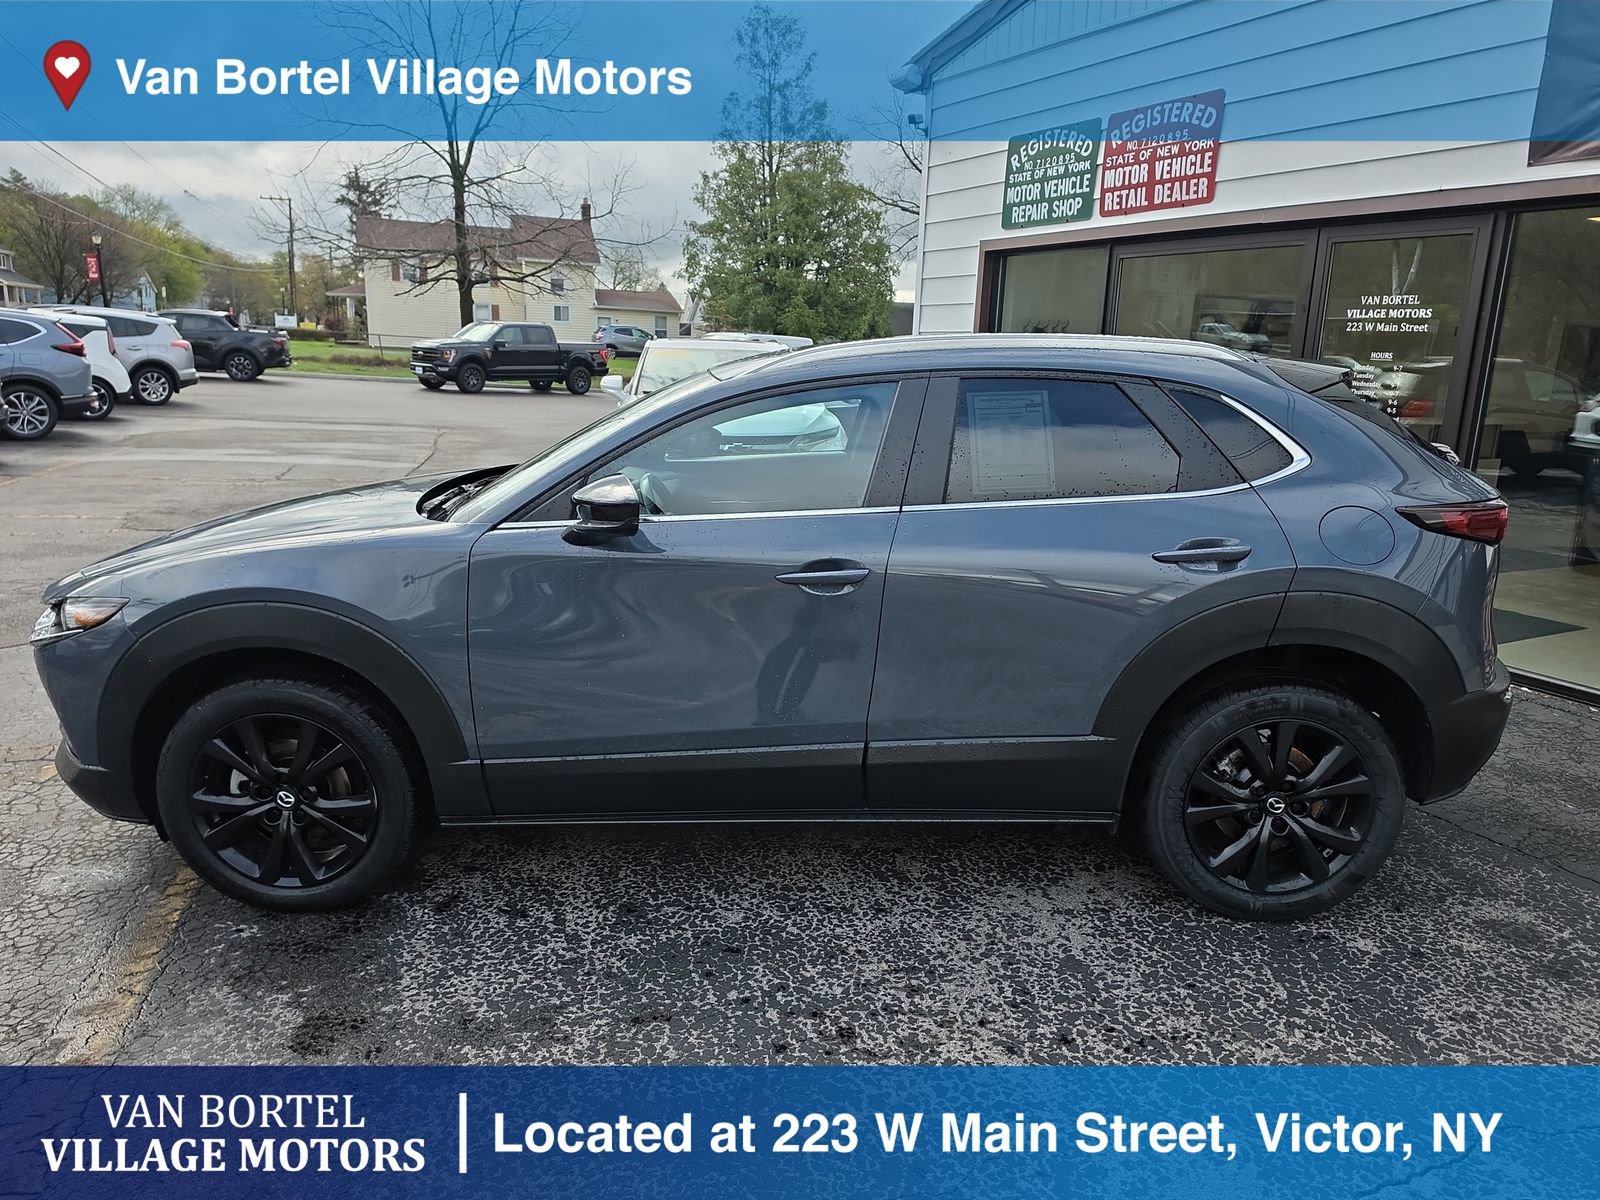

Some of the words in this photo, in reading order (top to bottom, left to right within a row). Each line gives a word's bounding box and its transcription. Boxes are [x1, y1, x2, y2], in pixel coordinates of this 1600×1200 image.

[1110, 102, 1217, 149] REGISTERED
[1141, 129, 1189, 147] 7120895
[1011, 129, 1093, 171] REGISTERED
[1035, 152, 1076, 169] 7120895
[1105, 152, 1136, 167] STATE
[1139, 148, 1153, 161] OF
[1156, 143, 1180, 158] NEW
[1184, 137, 1215, 153] YORK
[1009, 171, 1032, 183] STATE
[1034, 168, 1046, 179] OF
[1047, 164, 1066, 177] NEW
[1068, 160, 1091, 173] YORK
[1103, 163, 1149, 189] MOTOR
[1155, 152, 1213, 181] VEHICLE
[1006, 182, 1041, 205] MOTOR
[1044, 173, 1092, 199] VEHICLE
[1104, 187, 1148, 211] RETAIL
[1153, 177, 1209, 205] DEALER
[1012, 202, 1049, 223] REPAIR
[1052, 197, 1083, 218] SHOP
[1361, 295, 1380, 305] VAN
[1382, 295, 1420, 305] BORTEL
[1346, 309, 1386, 318] VILLAGE
[1388, 309, 1433, 318] MOTORS
[1346, 322, 1362, 332] 223
[1365, 323, 1374, 331] W
[1376, 323, 1398, 332] Main
[1400, 323, 1428, 332] Street
[1352, 380, 1382, 388] Wednesday
[1354, 372, 1375, 380] Tuesday
